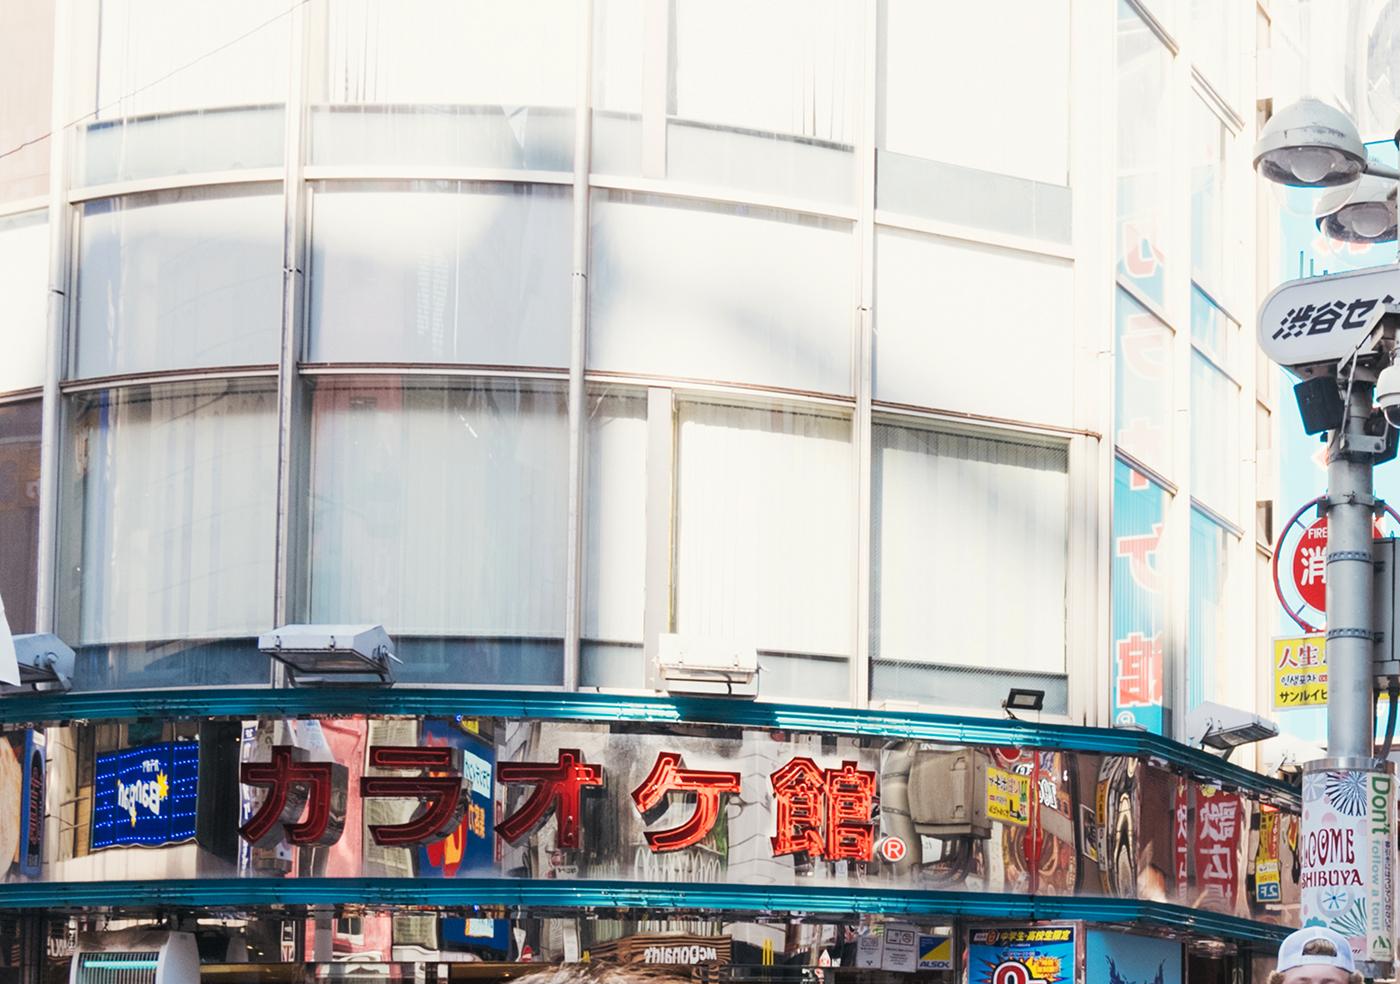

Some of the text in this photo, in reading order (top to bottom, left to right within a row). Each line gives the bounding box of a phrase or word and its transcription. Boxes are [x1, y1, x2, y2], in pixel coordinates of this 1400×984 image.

[239, 745, 877, 862] カラオケ館
[1371, 776, 1392, 836] Don't
[1301, 869, 1363, 889] SHIBUYA
[1371, 839, 1380, 882] follow
[919, 960, 951, 969] ALSOK
